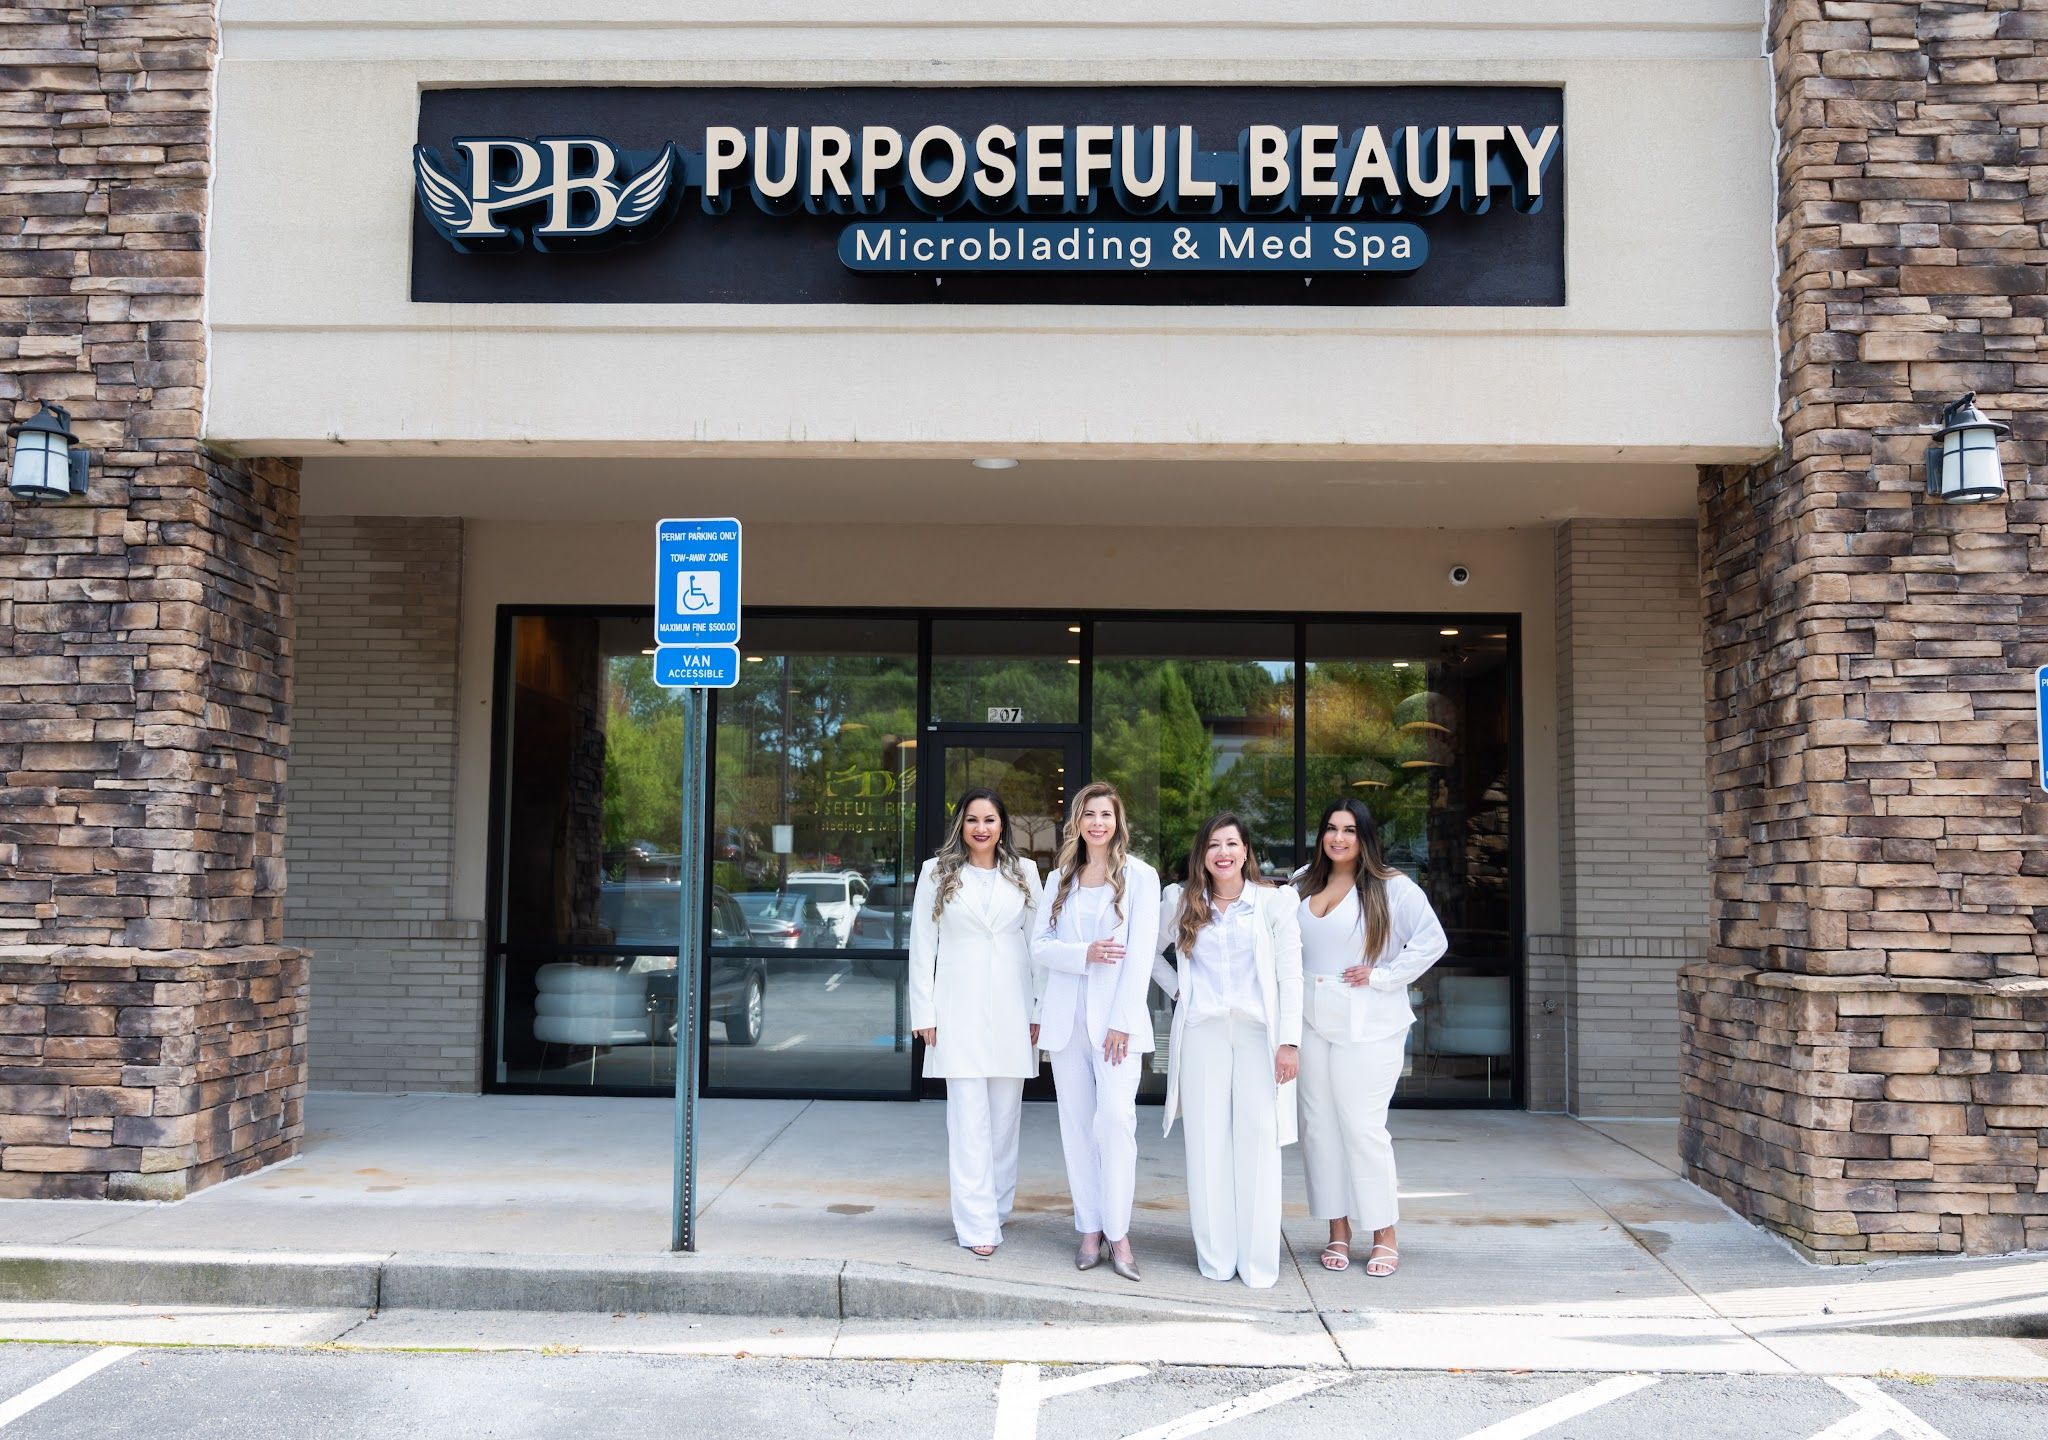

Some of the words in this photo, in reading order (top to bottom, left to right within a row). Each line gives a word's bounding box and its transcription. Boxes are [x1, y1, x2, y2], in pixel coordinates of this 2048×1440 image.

[705, 124, 1217, 198] PURPOSEFUL
[1249, 124, 1559, 198] BEAUTY
[457, 139, 620, 234] PB
[855, 227, 1152, 269] Microblading
[1171, 227, 1201, 260] &
[1218, 226, 1313, 260] Med
[1332, 226, 1412, 267] Spa
[661, 532, 687, 542] PERMIT
[688, 531, 718, 541] PARKING
[719, 531, 737, 541] ONLY
[670, 553, 707, 563] TOW-AWAY
[708, 552, 729, 562] ZONE
[659, 623, 691, 632] MAXIMUM
[692, 622, 707, 632] FINE
[708, 622, 736, 632] $500.00
[682, 654, 711, 668] VAN
[668, 669, 724, 679] ACCESSIBLE
[989, 708, 1020, 723] 207
